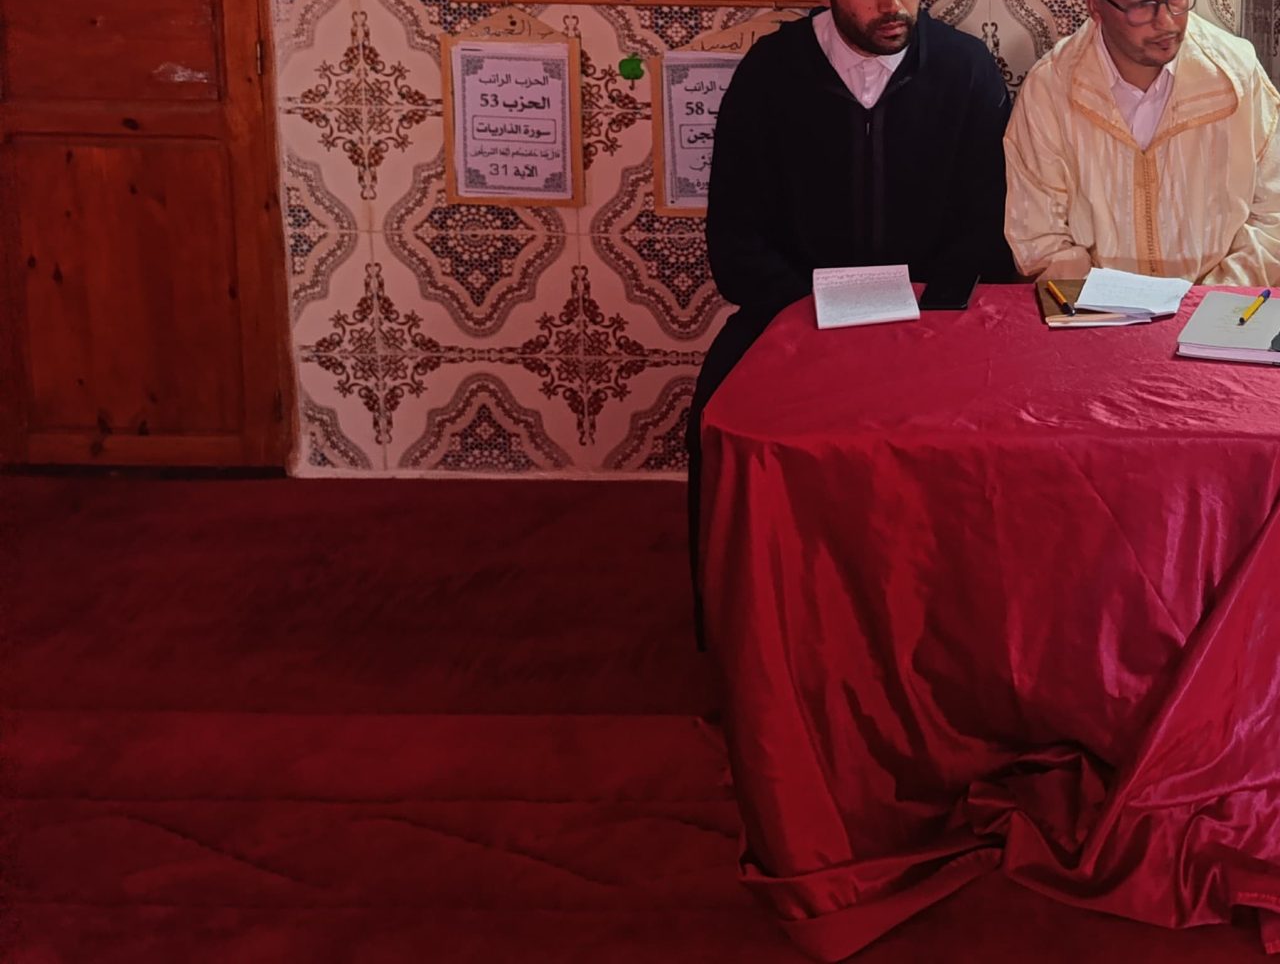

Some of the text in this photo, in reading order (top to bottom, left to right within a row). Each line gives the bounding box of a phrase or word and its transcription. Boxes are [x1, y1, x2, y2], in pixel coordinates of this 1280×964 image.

[478, 72, 549, 89] الحزب الراتب
[684, 80, 717, 95] الراتب
[480, 93, 551, 113] الحزب 53
[685, 101, 705, 116] 58
[475, 122, 551, 139] سورة الذاريات
[489, 163, 508, 176] 31
